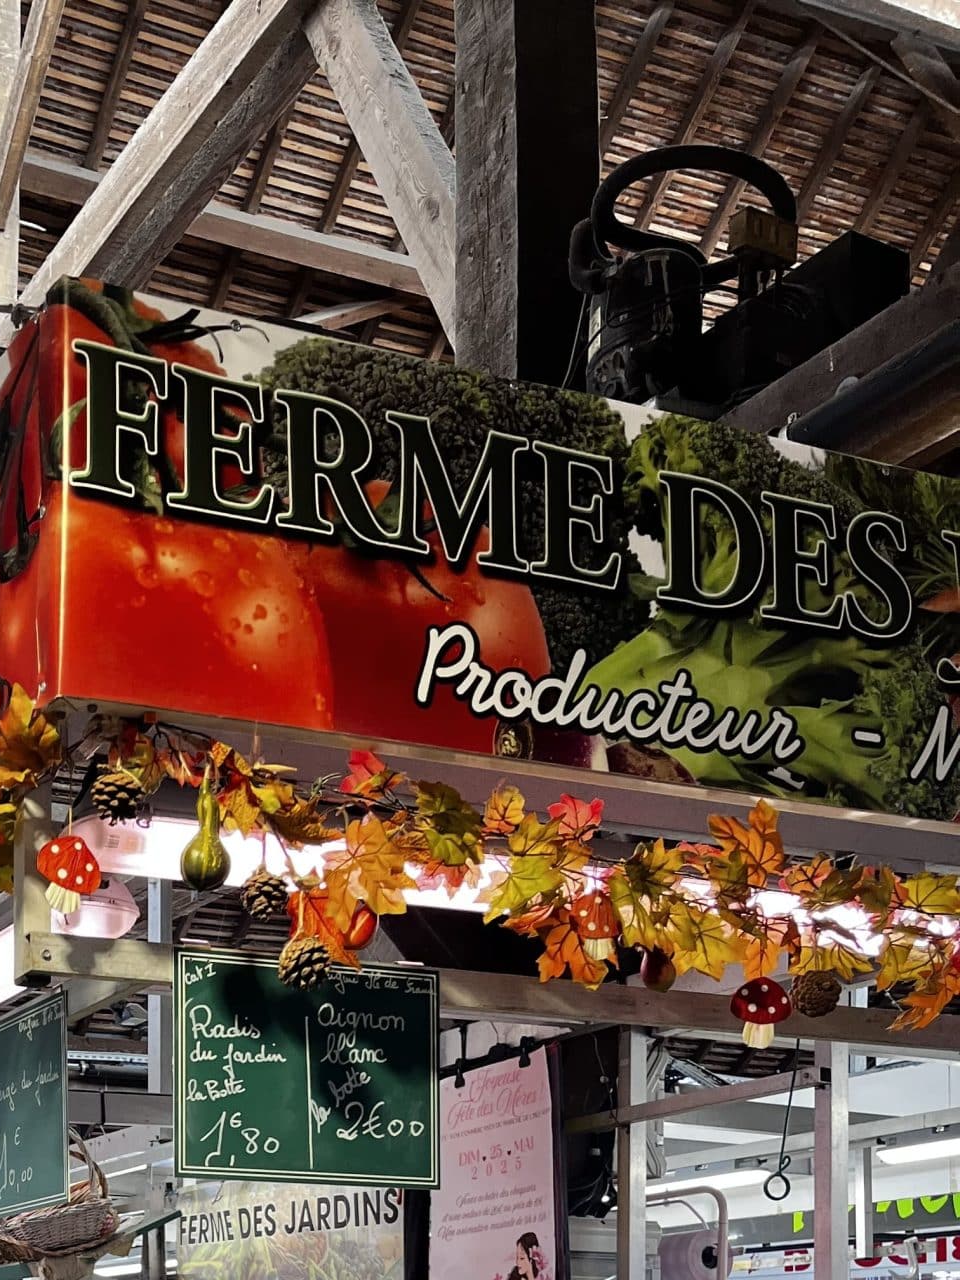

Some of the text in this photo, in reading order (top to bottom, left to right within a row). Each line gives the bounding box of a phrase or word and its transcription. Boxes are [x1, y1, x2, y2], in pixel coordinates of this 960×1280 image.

[69, 338, 626, 591] FERME
[657, 470, 913, 639] DES
[417, 626, 802, 759] Producteur
[186, 998, 262, 1039] Radis
[317, 1002, 406, 1048] Oignon
[190, 1041, 217, 1063] du
[320, 1033, 388, 1065] blanc
[179, 1210, 234, 1246] FERME
[238, 1203, 277, 1239] DES
[284, 1188, 400, 1234] JARDINS
